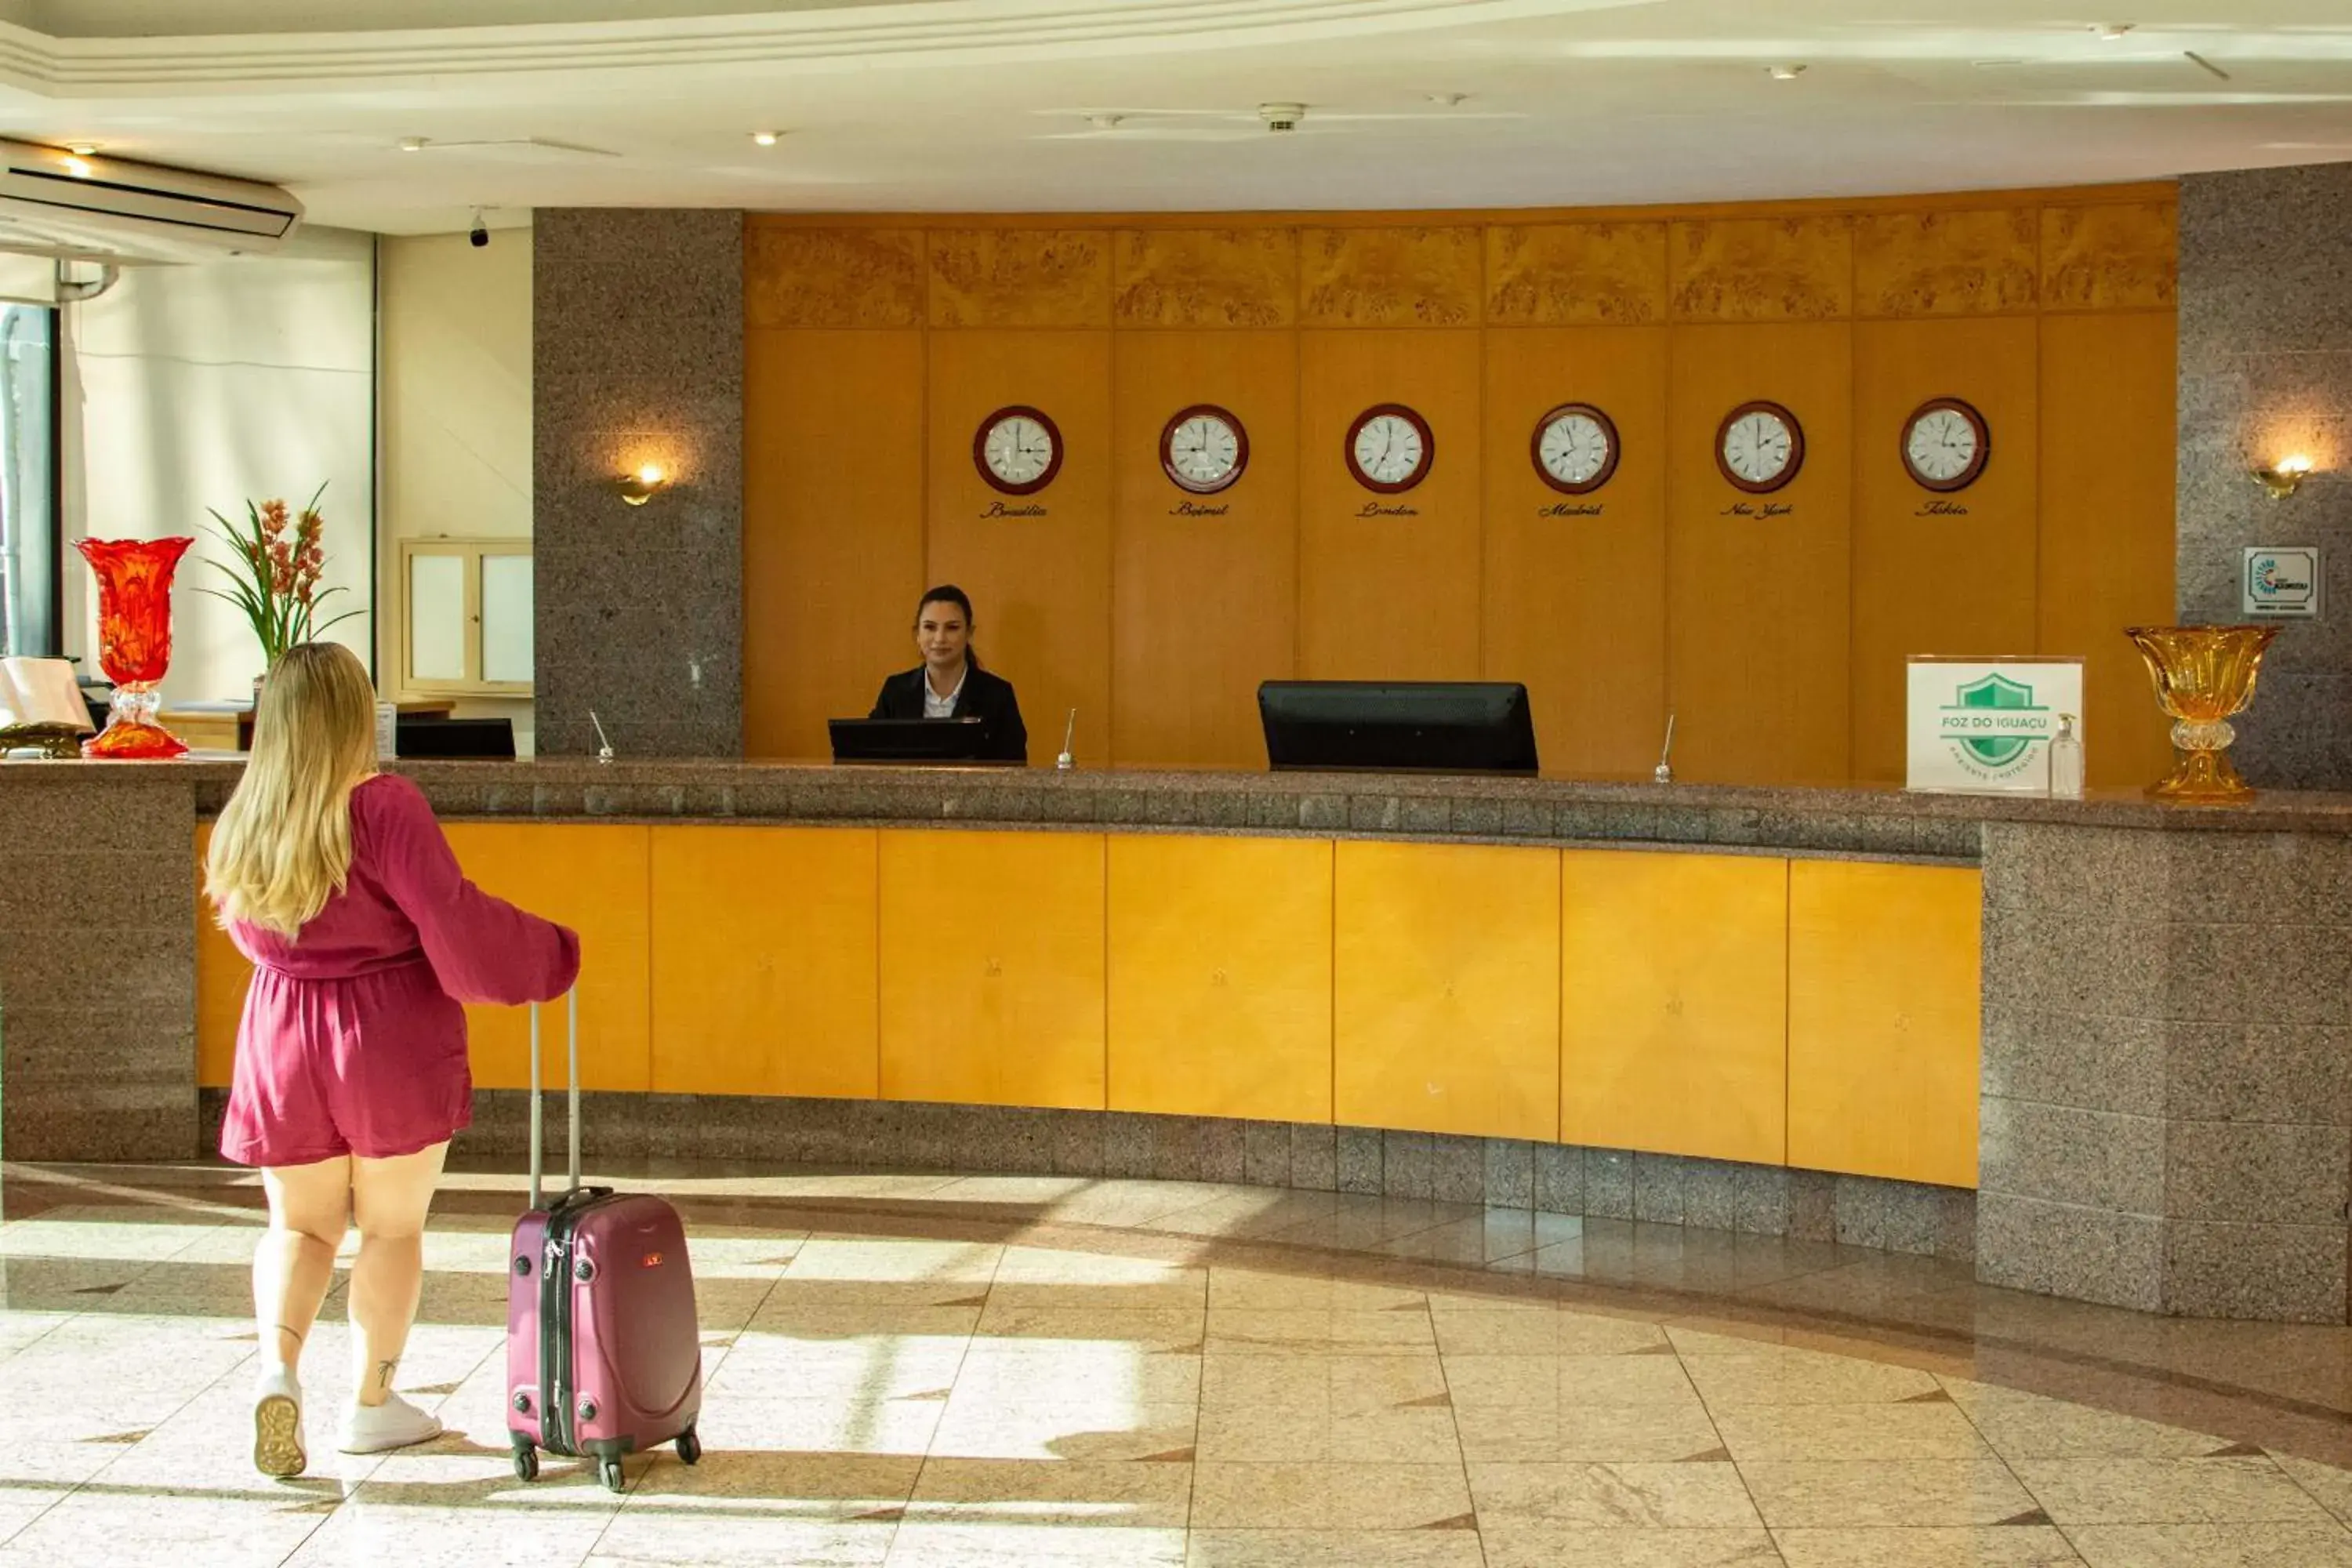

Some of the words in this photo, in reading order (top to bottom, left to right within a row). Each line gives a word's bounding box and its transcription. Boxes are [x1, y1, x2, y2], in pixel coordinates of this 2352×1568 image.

[1354, 501, 1419, 517] London
[1538, 503, 1603, 517] Madrid
[1720, 502, 1754, 516] New
[1753, 503, 1794, 521] York
[1941, 717, 1969, 728] FOZ
[1972, 717, 1992, 728] DO
[1997, 717, 2047, 730] IGUAÇU
